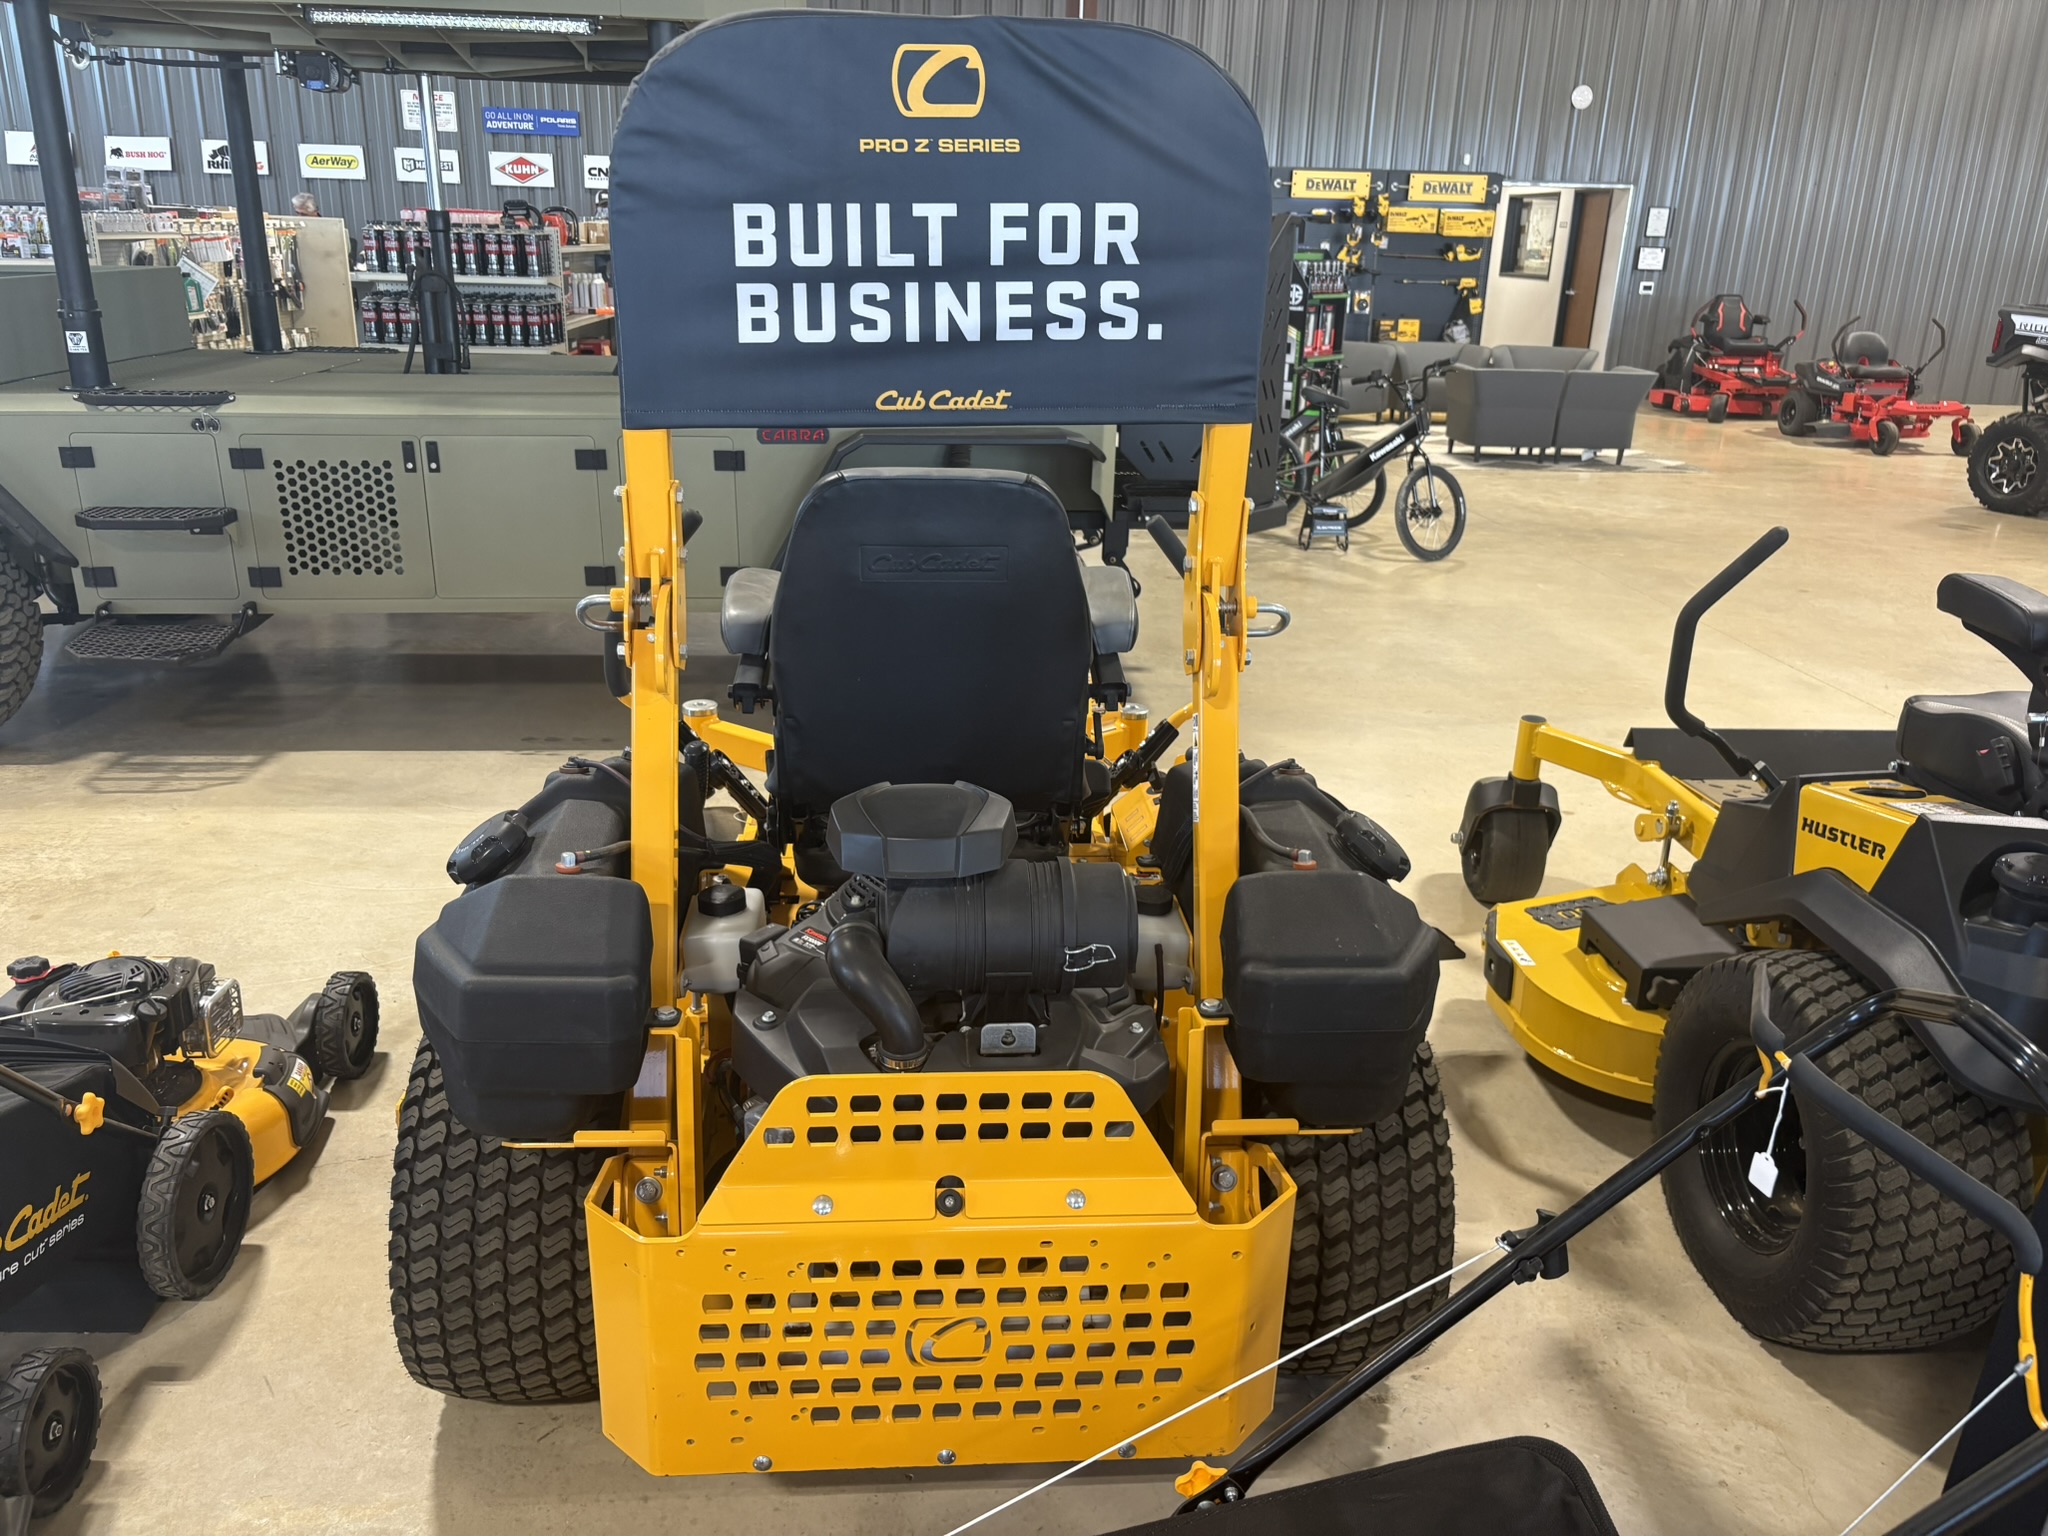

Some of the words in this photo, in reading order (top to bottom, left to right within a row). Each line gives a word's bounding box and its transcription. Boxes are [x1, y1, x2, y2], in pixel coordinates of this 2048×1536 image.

[485, 111, 496, 120] GO
[497, 112, 511, 120] ALL
[513, 113, 522, 121] IN
[522, 113, 534, 121] ON
[540, 116, 577, 125] POLARIS
[486, 120, 535, 130] ADVENTURE
[859, 138, 909, 153] PRO
[914, 138, 930, 153] Z
[938, 138, 1021, 153] SERIES
[146, 151, 165, 159] HOG
[311, 156, 354, 169] AerWay
[504, 164, 540, 175] KUHN
[588, 167, 609, 178] CN
[732, 202, 959, 268] BUILT
[989, 201, 1141, 266] FOR
[735, 280, 1163, 345] BUSINESS.
[875, 389, 926, 411] Cub
[928, 389, 1012, 410] Cadet
[761, 428, 826, 442] CABRA
[1369, 433, 1406, 462] Kawasaki
[867, 552, 917, 573] Cub
[917, 552, 1001, 572] Cadet
[1801, 816, 1887, 860] HUSTLER
[4, 1170, 91, 1252] Cadet
[24, 1241, 46, 1266] cut
[48, 1213, 85, 1248] series
